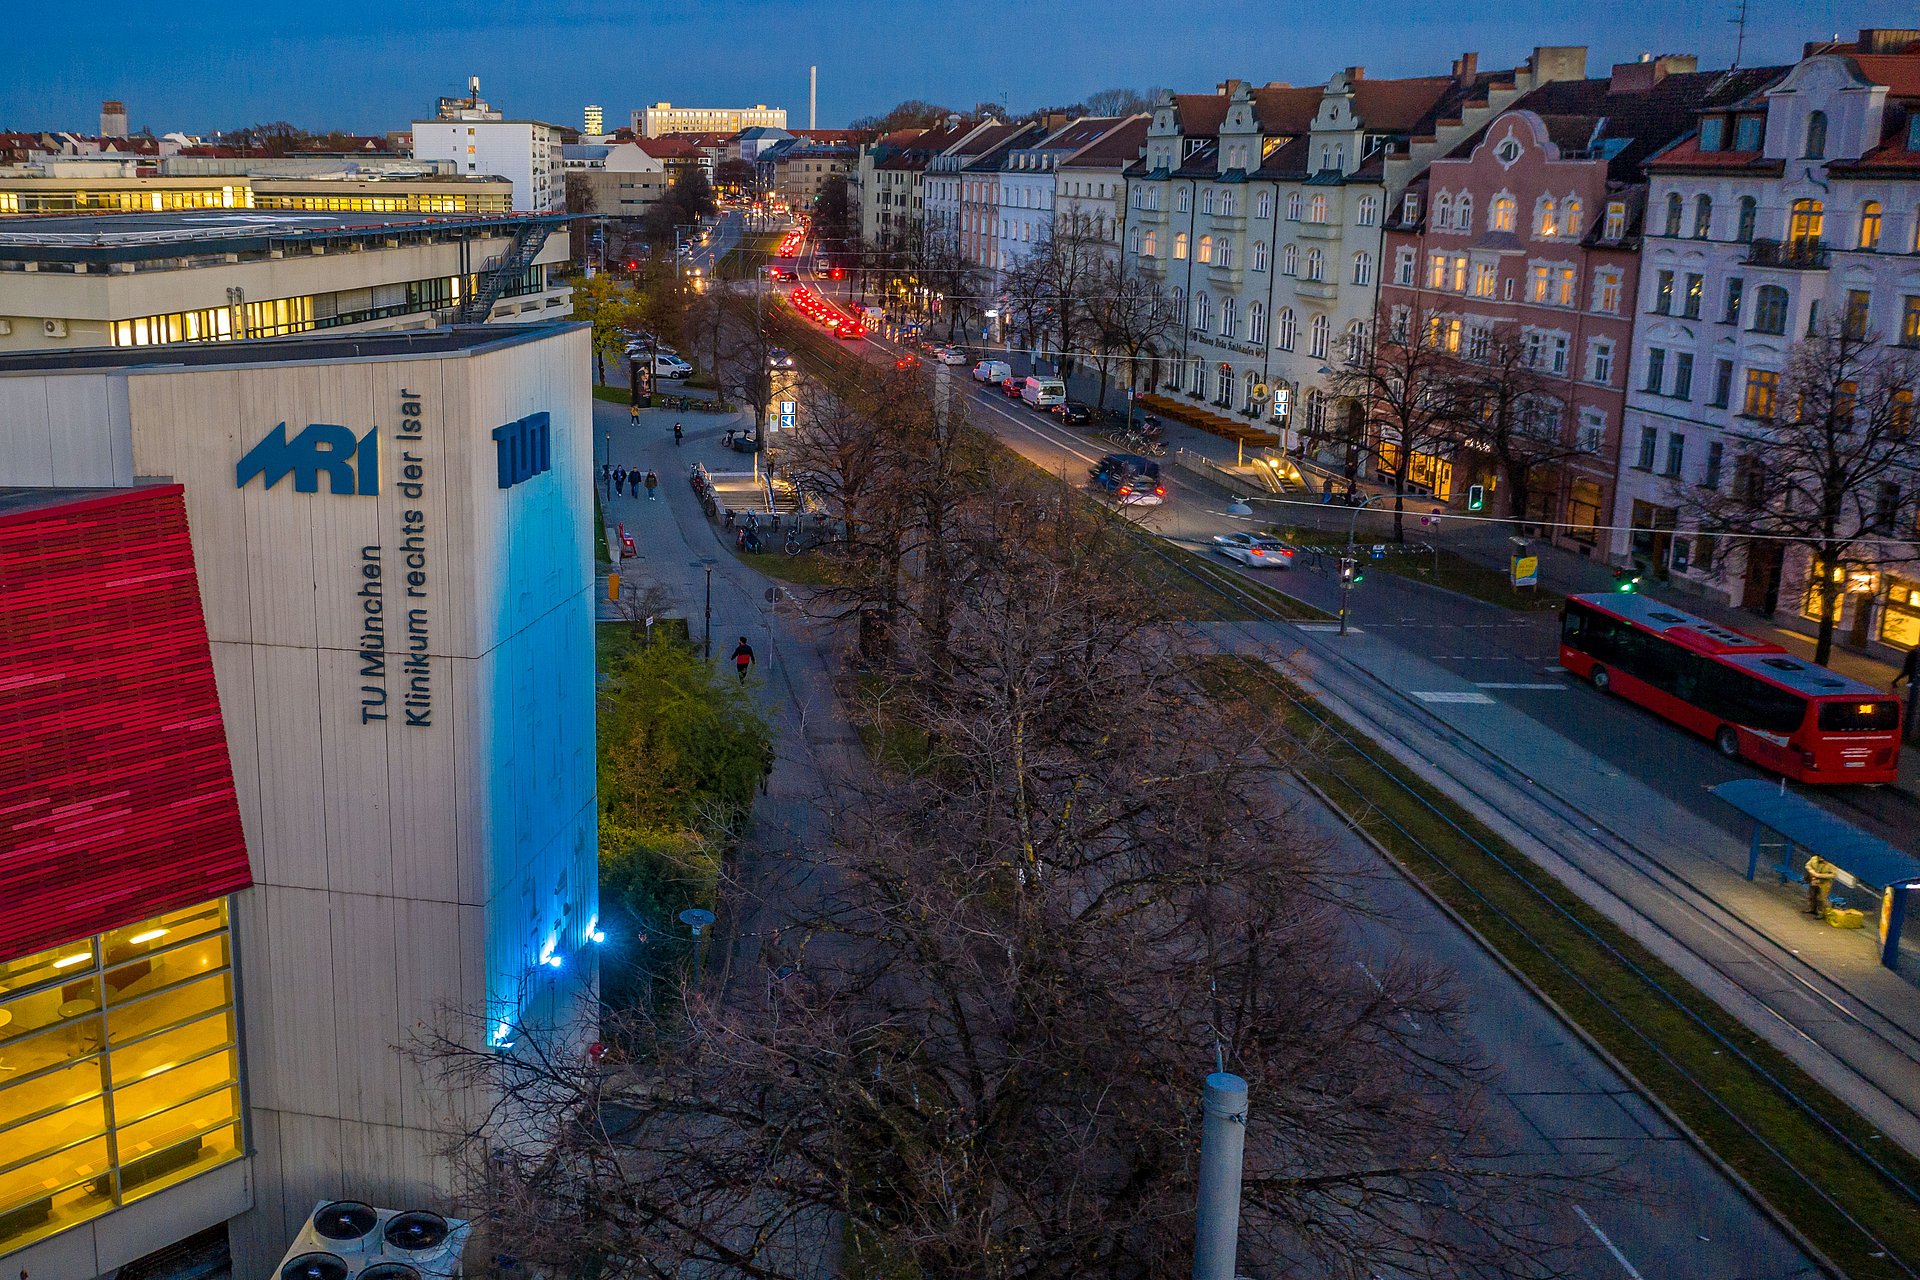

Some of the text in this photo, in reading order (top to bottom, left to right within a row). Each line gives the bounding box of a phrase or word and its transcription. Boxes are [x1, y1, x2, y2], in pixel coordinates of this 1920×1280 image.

[236, 421, 380, 496] MRI
[357, 545, 388, 725] TU München
[396, 388, 432, 728] Klinikum rechts der Isar
